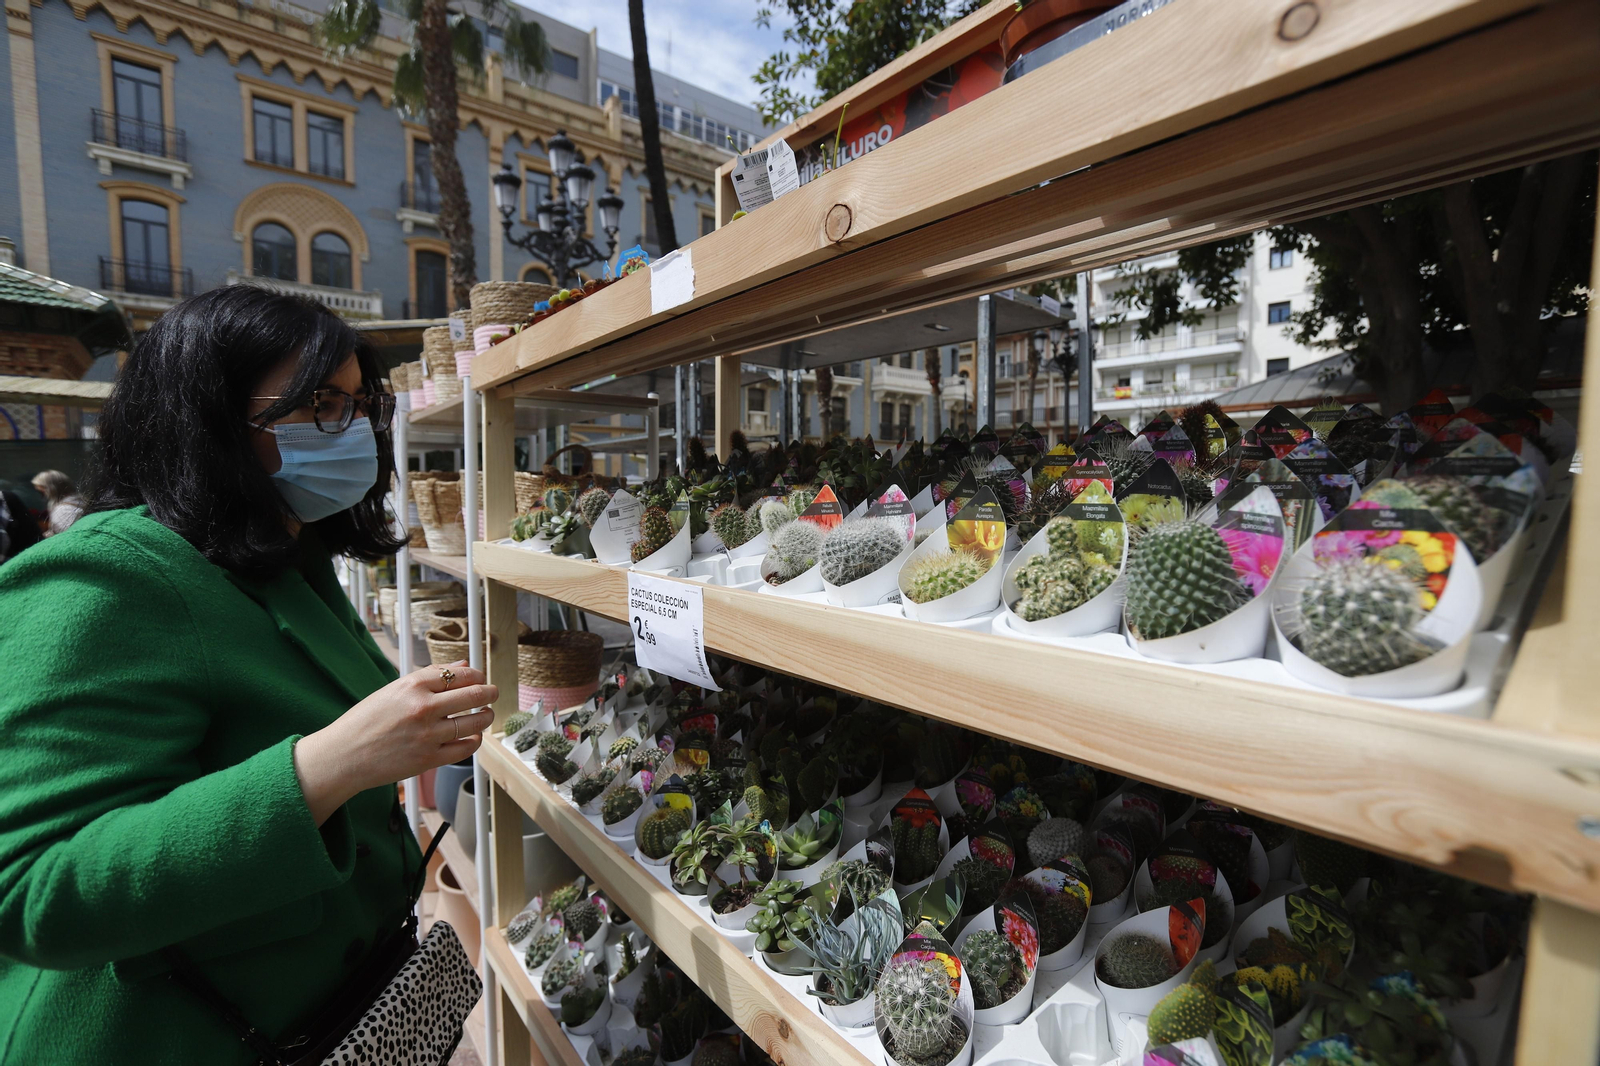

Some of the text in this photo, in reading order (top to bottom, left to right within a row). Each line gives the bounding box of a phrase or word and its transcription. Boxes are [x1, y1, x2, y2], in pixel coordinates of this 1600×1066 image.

[1086, 512, 1106, 520] Elongata
[1371, 519, 1405, 528] Cactus
[631, 587, 689, 610] CACTUS COLECCIÓN
[631, 599, 658, 615] ESPECIAL
[667, 608, 678, 620] CM
[633, 615, 646, 641] 2
